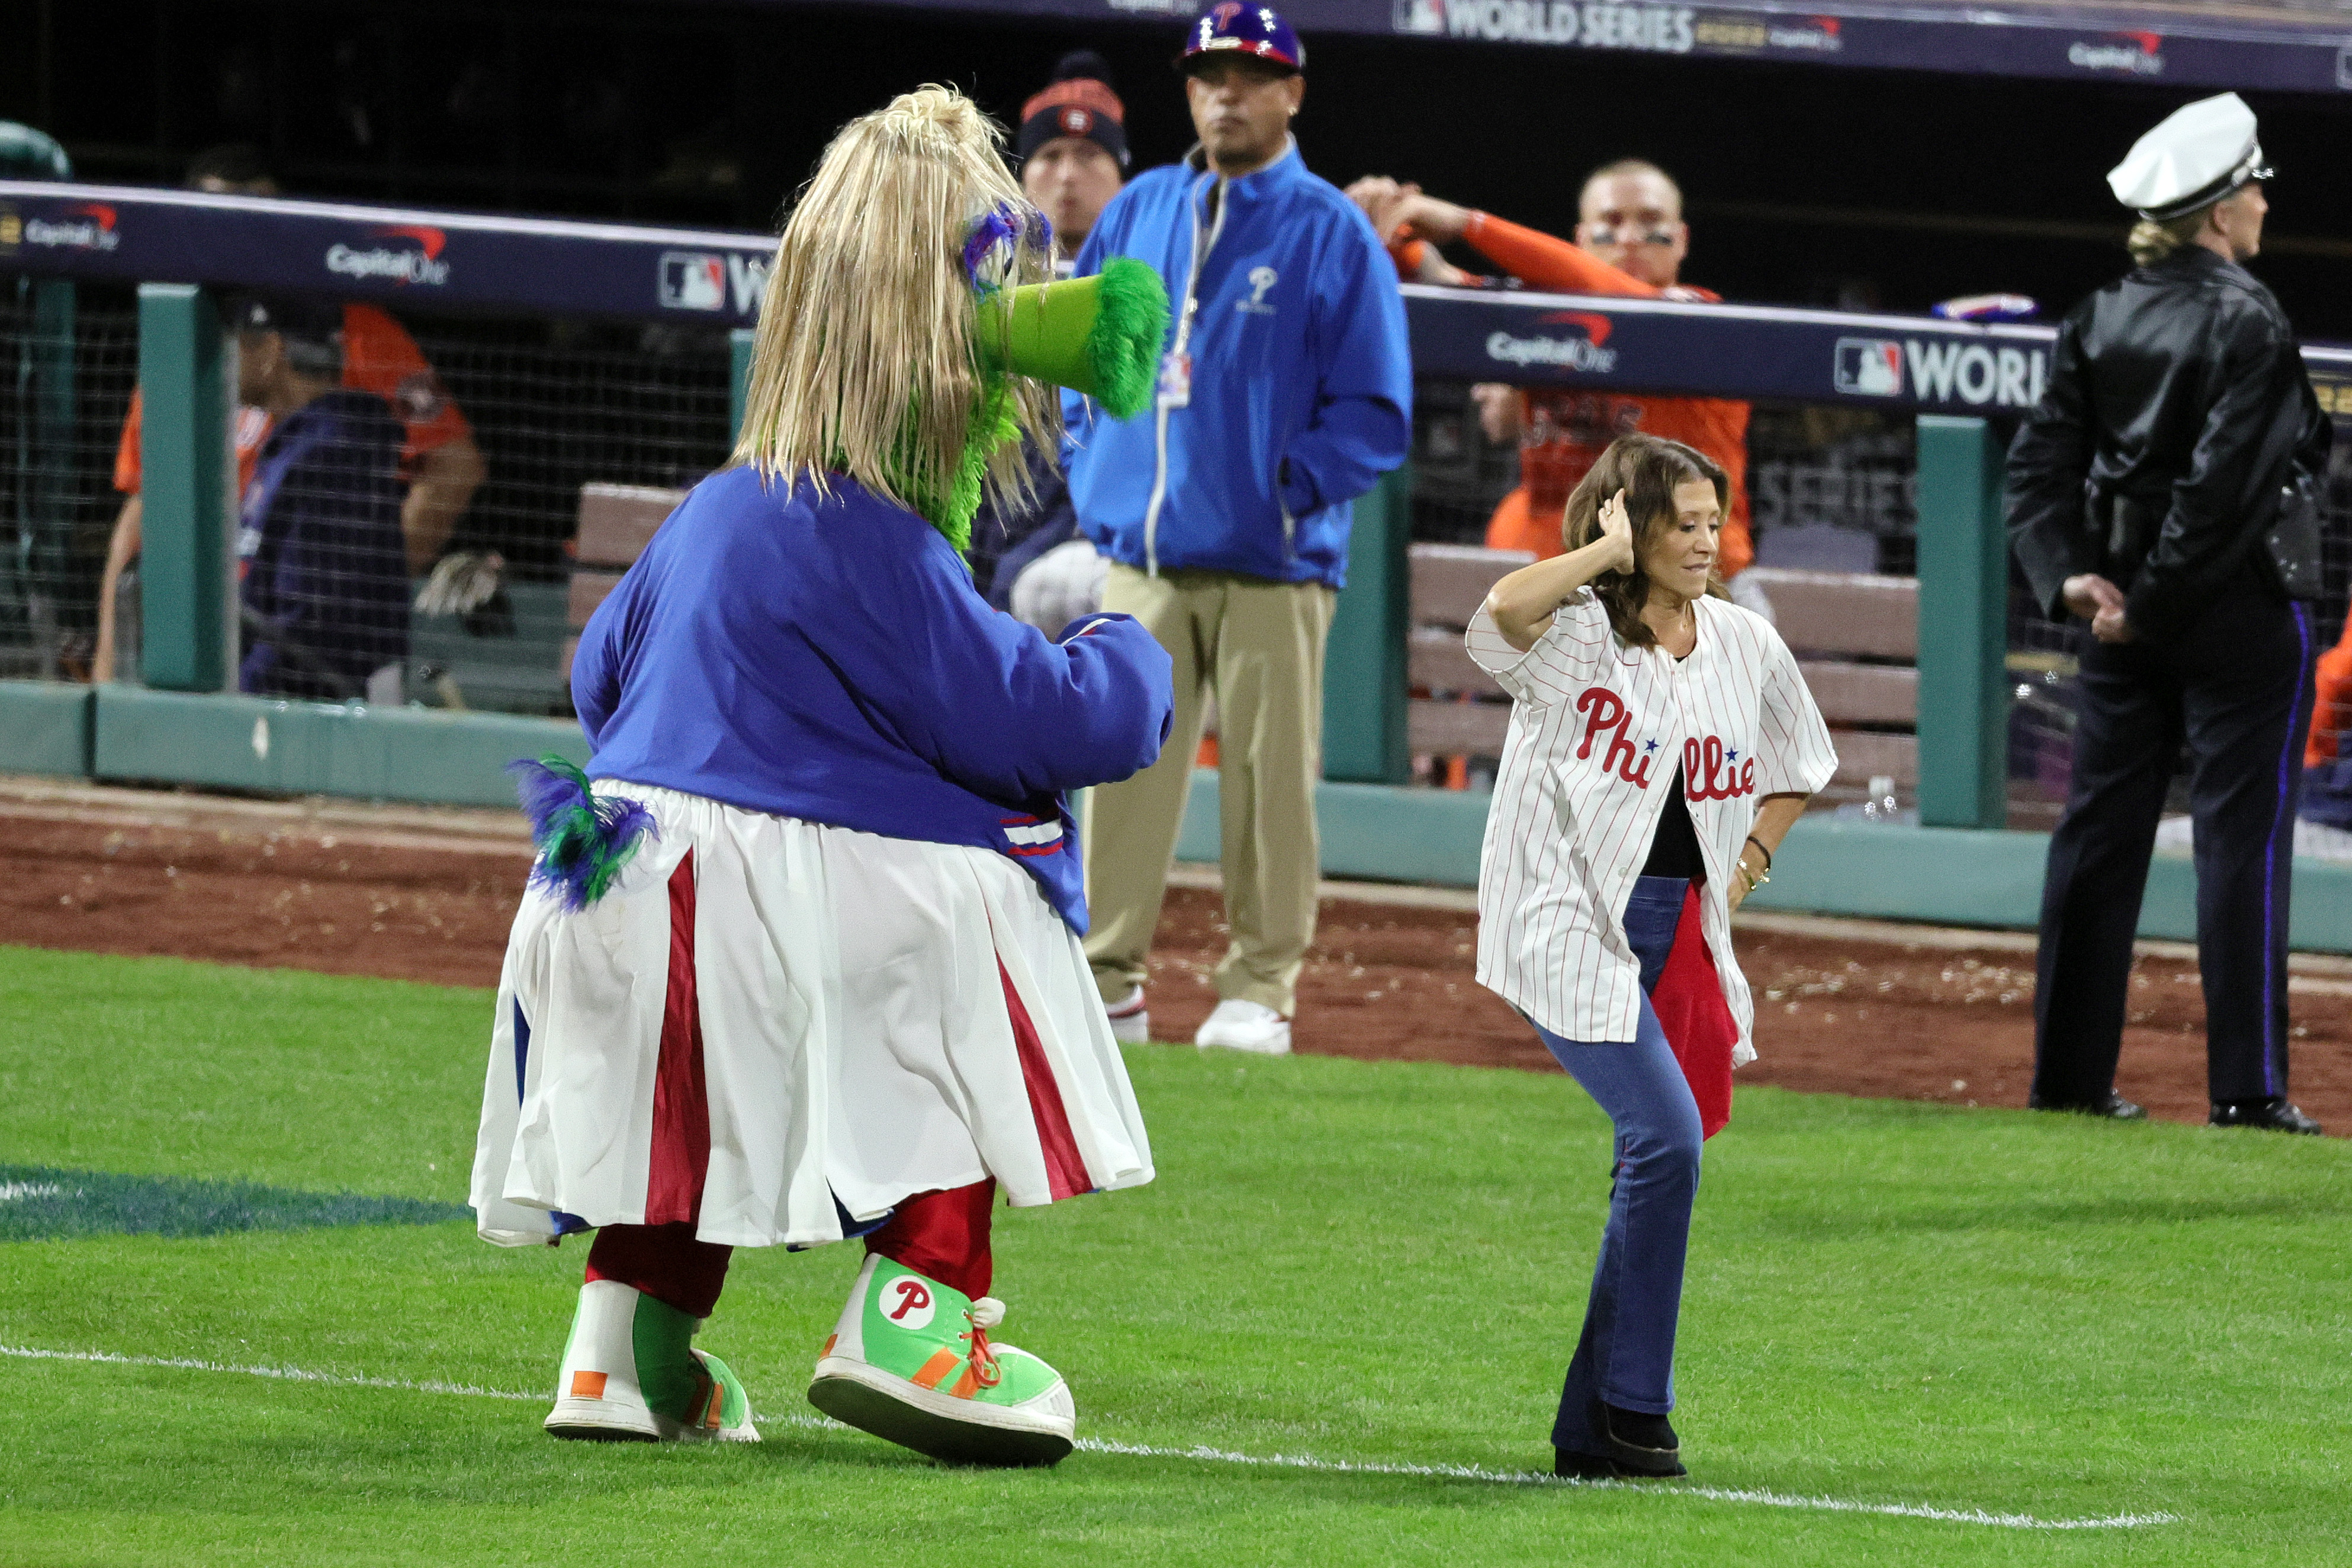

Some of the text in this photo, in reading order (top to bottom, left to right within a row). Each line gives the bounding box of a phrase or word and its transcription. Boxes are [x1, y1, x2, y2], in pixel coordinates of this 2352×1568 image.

[1447, 0, 1579, 43] WORLD
[1580, 4, 1694, 53] SERIES
[1906, 338, 2045, 407] WORL
[890, 1281, 930, 1320] P
